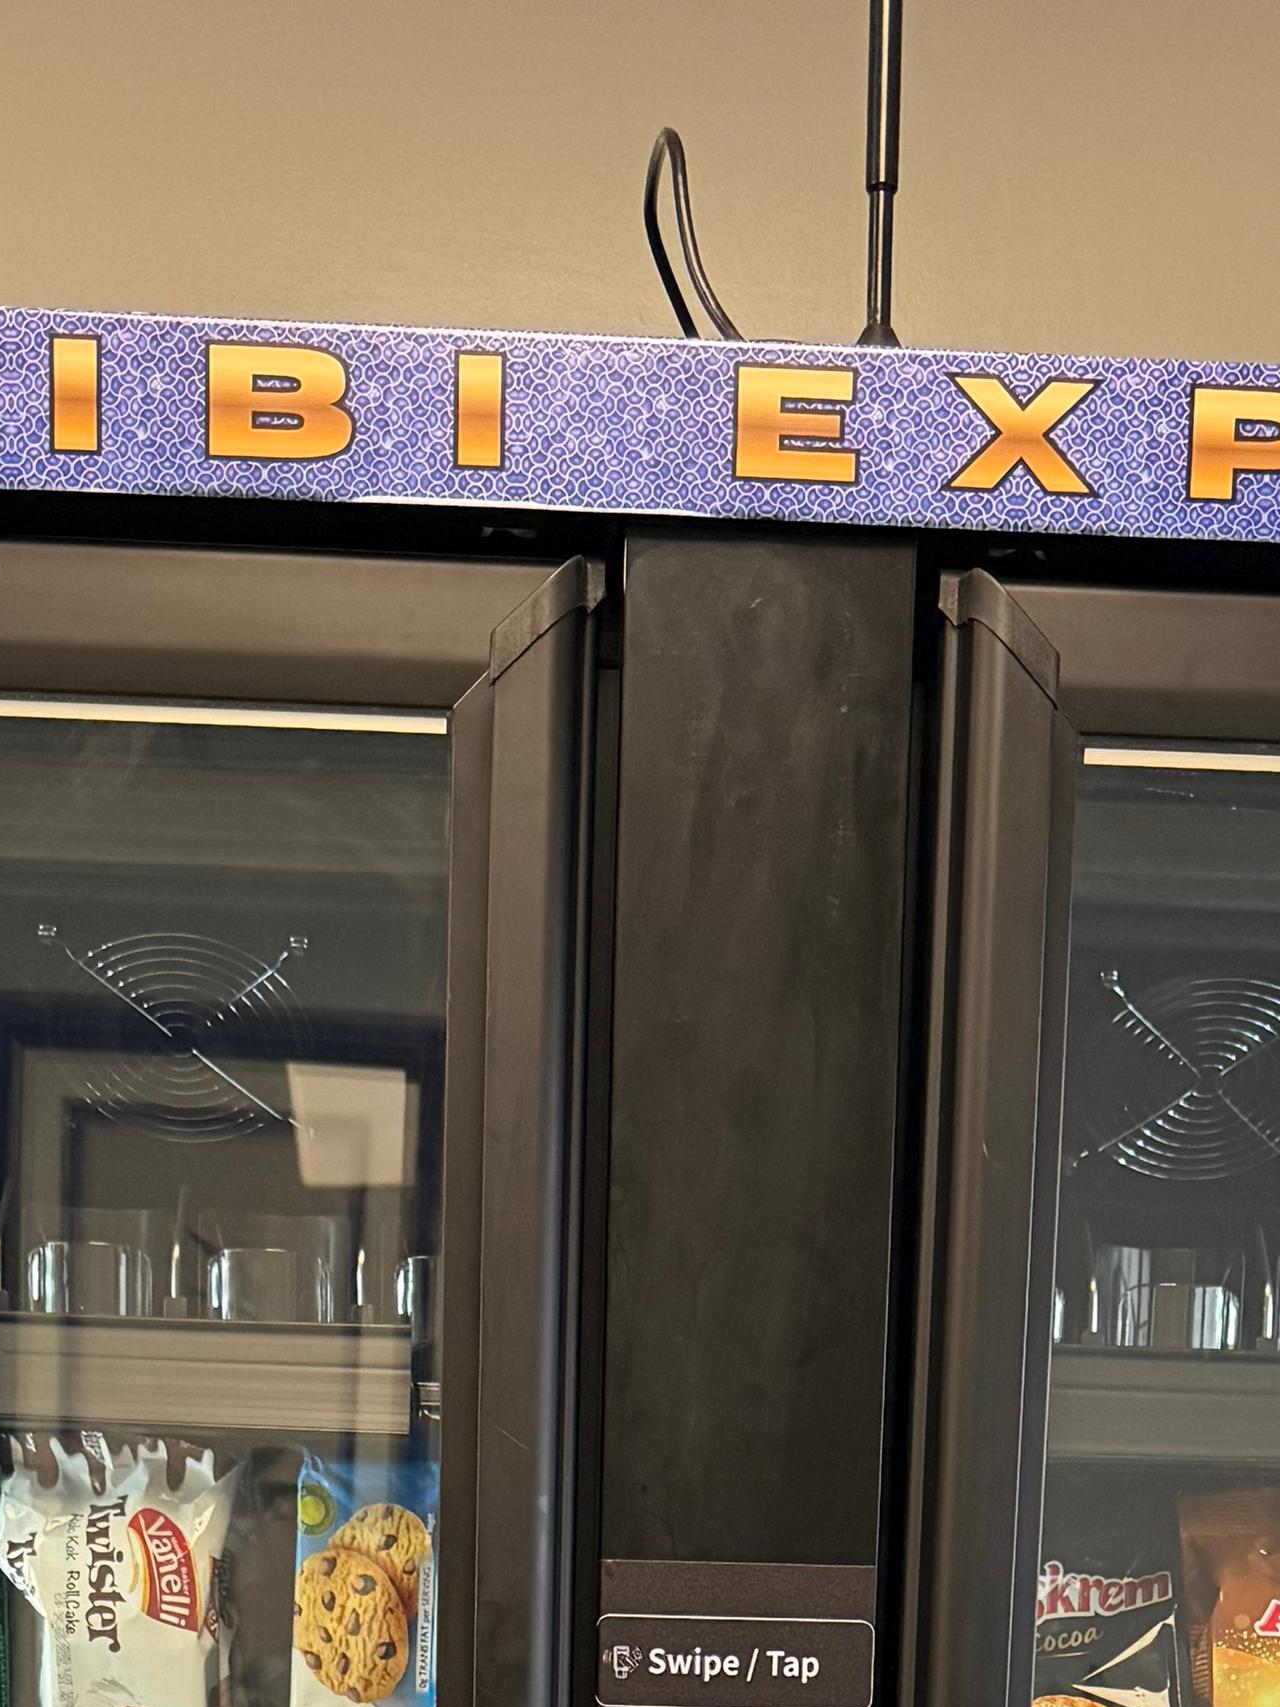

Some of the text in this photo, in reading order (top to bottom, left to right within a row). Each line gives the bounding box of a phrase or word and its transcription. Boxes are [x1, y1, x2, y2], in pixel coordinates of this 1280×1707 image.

[66, 1570, 80, 1634] Roll Cake
[86, 1495, 128, 1653] Twister
[147, 1516, 191, 1626] Vanelli
[648, 1648, 820, 1683] Swipe / Tap
